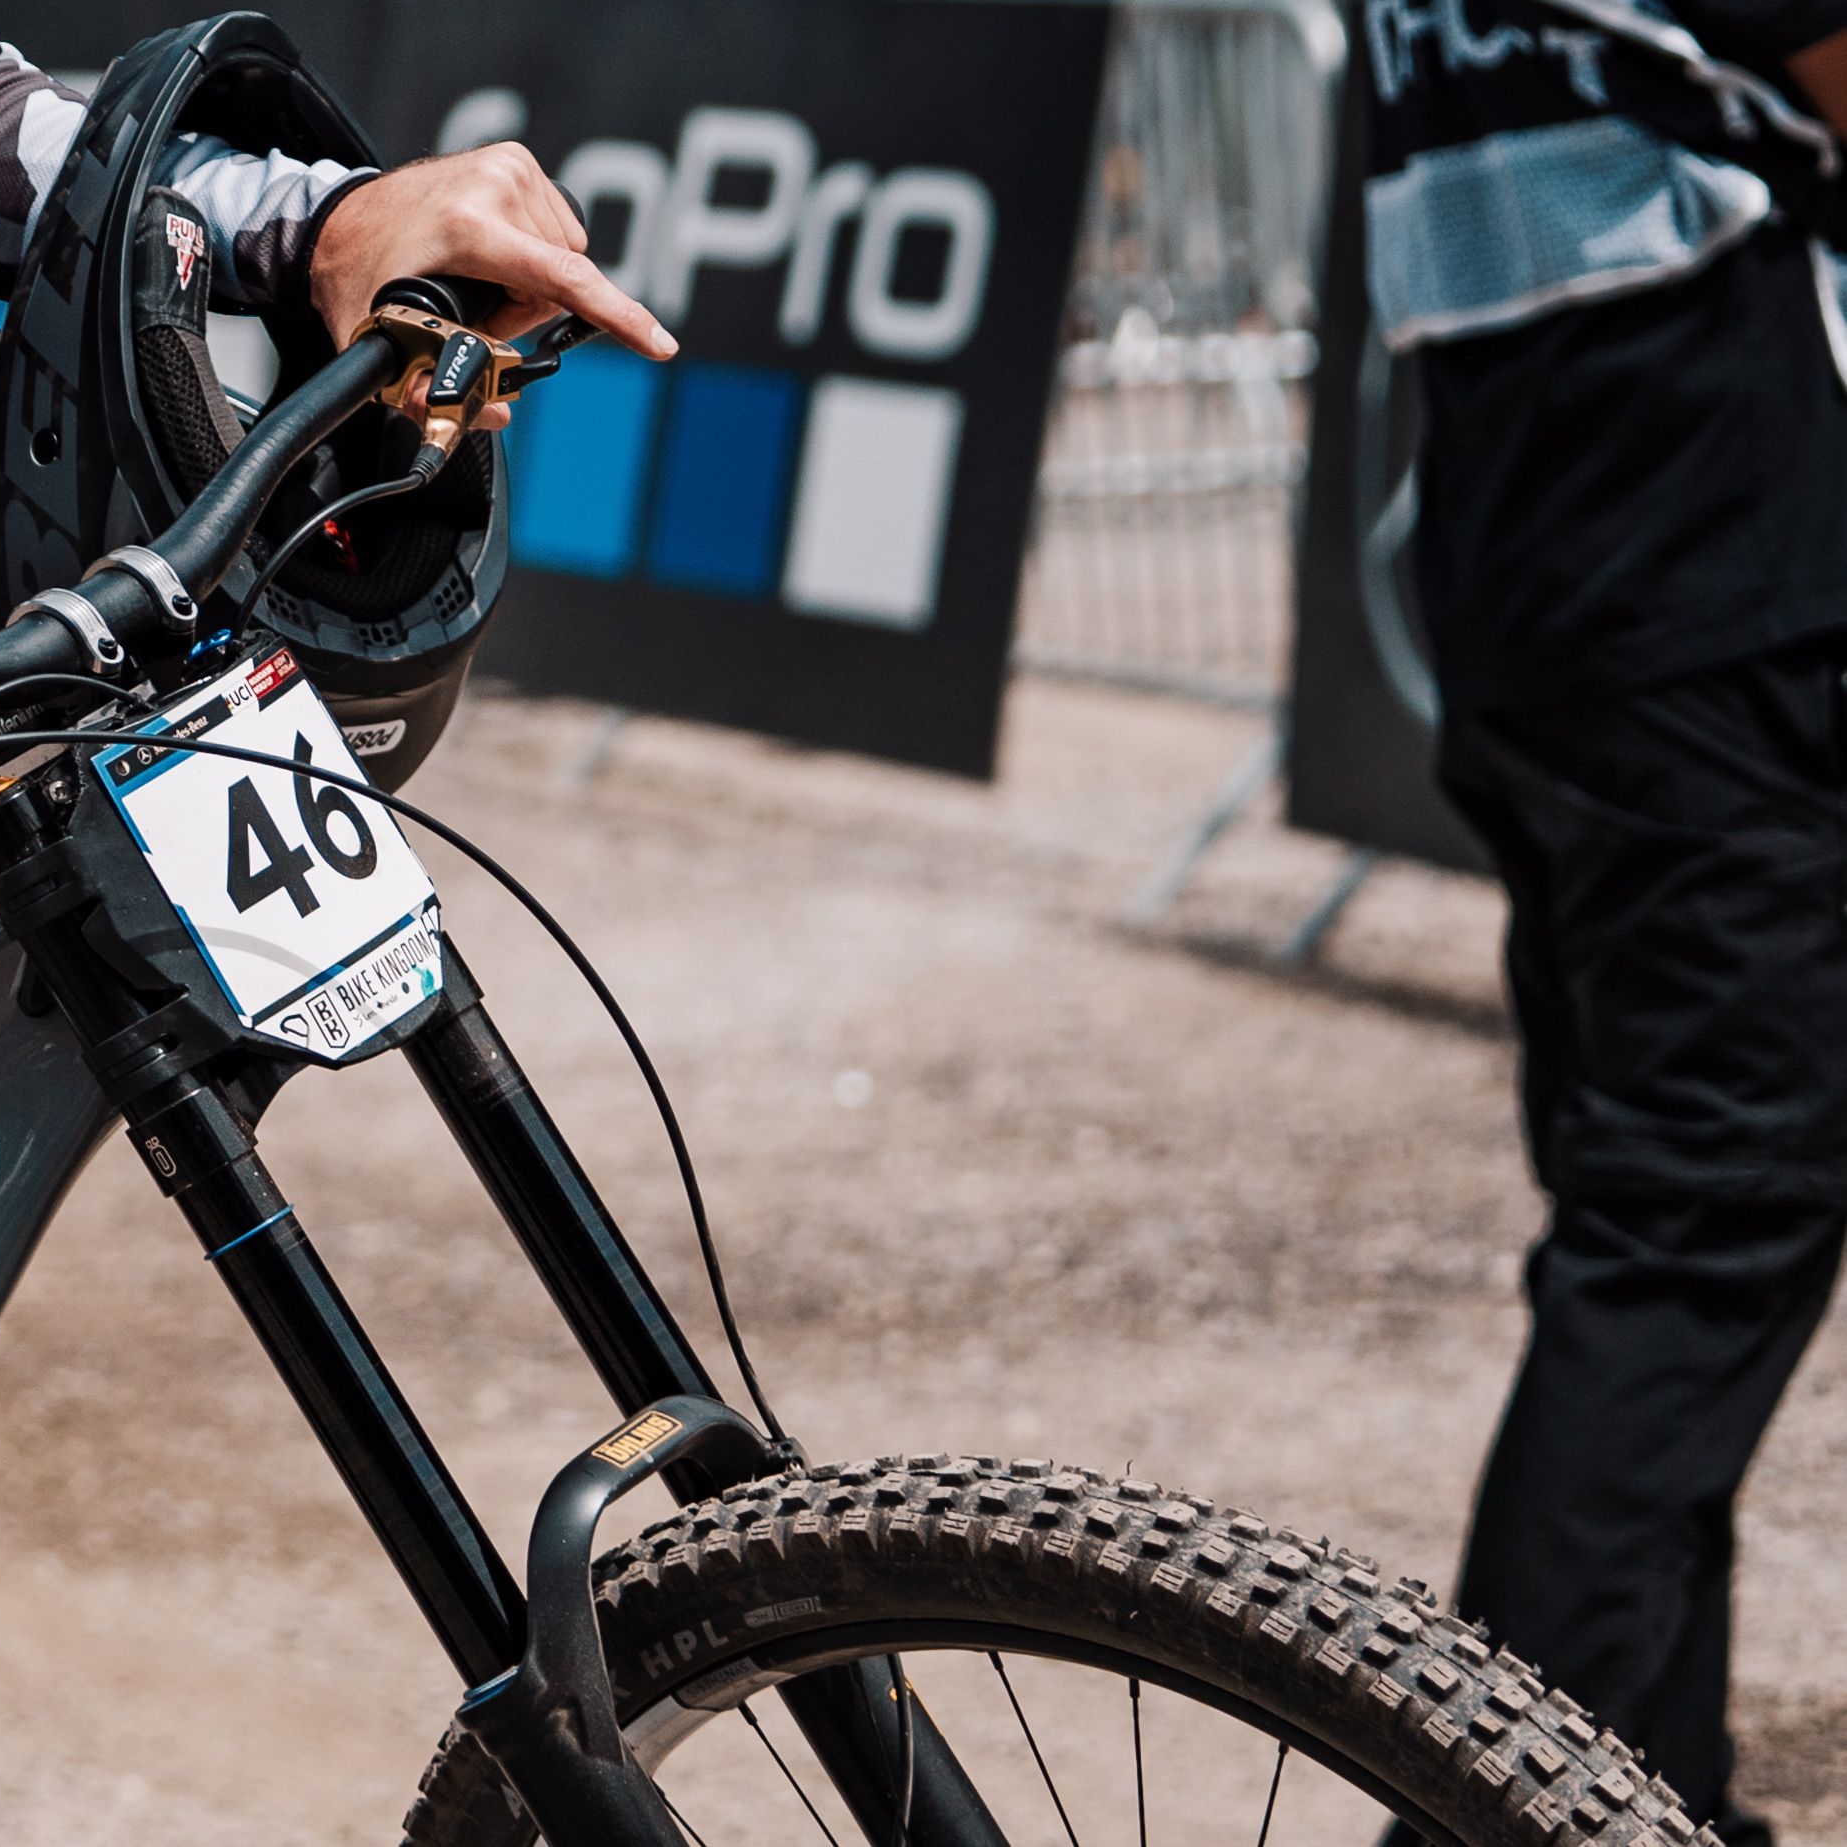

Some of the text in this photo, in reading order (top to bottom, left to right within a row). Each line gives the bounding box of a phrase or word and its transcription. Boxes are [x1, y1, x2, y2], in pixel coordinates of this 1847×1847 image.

[435, 87, 998, 363] oPro
[446, 344, 469, 382] TRP
[229, 683, 253, 707] UCI
[345, 725, 399, 750] POSI
[226, 729, 378, 919] 46
[336, 970, 378, 1012] BIKE
[371, 930, 435, 989] KINGDOM
[598, 1415, 675, 1463] ÖHLINS
[638, 1618, 730, 1680] HPL
